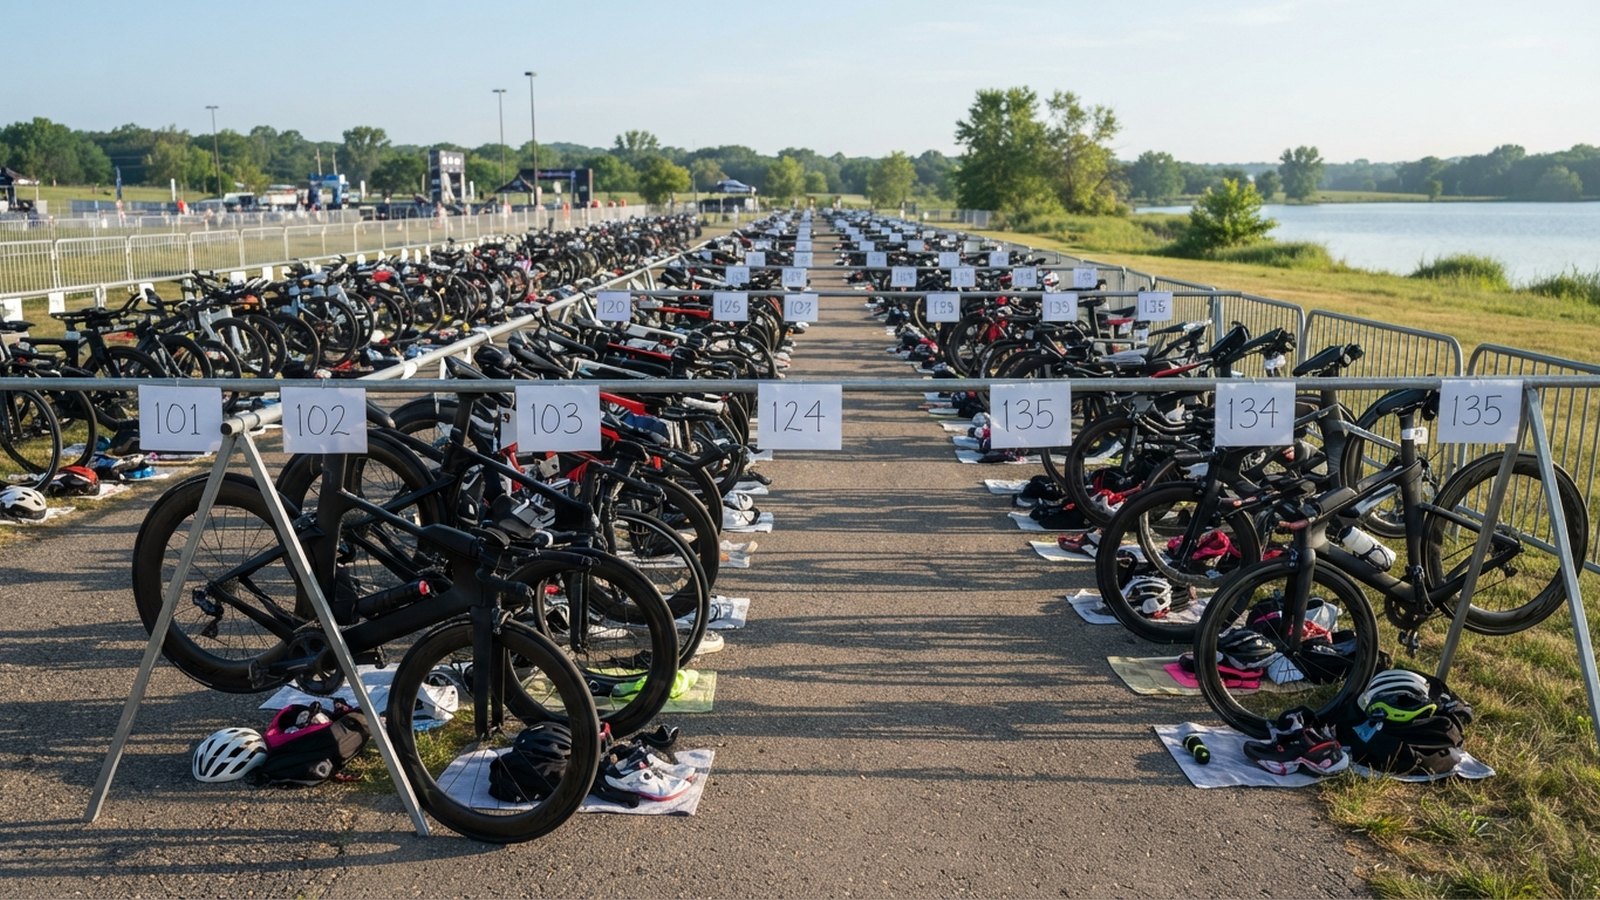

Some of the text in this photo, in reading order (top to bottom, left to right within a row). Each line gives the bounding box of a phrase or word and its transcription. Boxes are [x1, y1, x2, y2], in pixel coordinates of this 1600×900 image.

[602, 299, 625, 314] 120
[155, 401, 201, 436] 101
[296, 403, 351, 437] 102
[530, 402, 583, 435] 103
[772, 400, 827, 433] 124
[1003, 398, 1054, 433] 135
[1228, 396, 1280, 430] 134
[1452, 394, 1503, 427] 135
